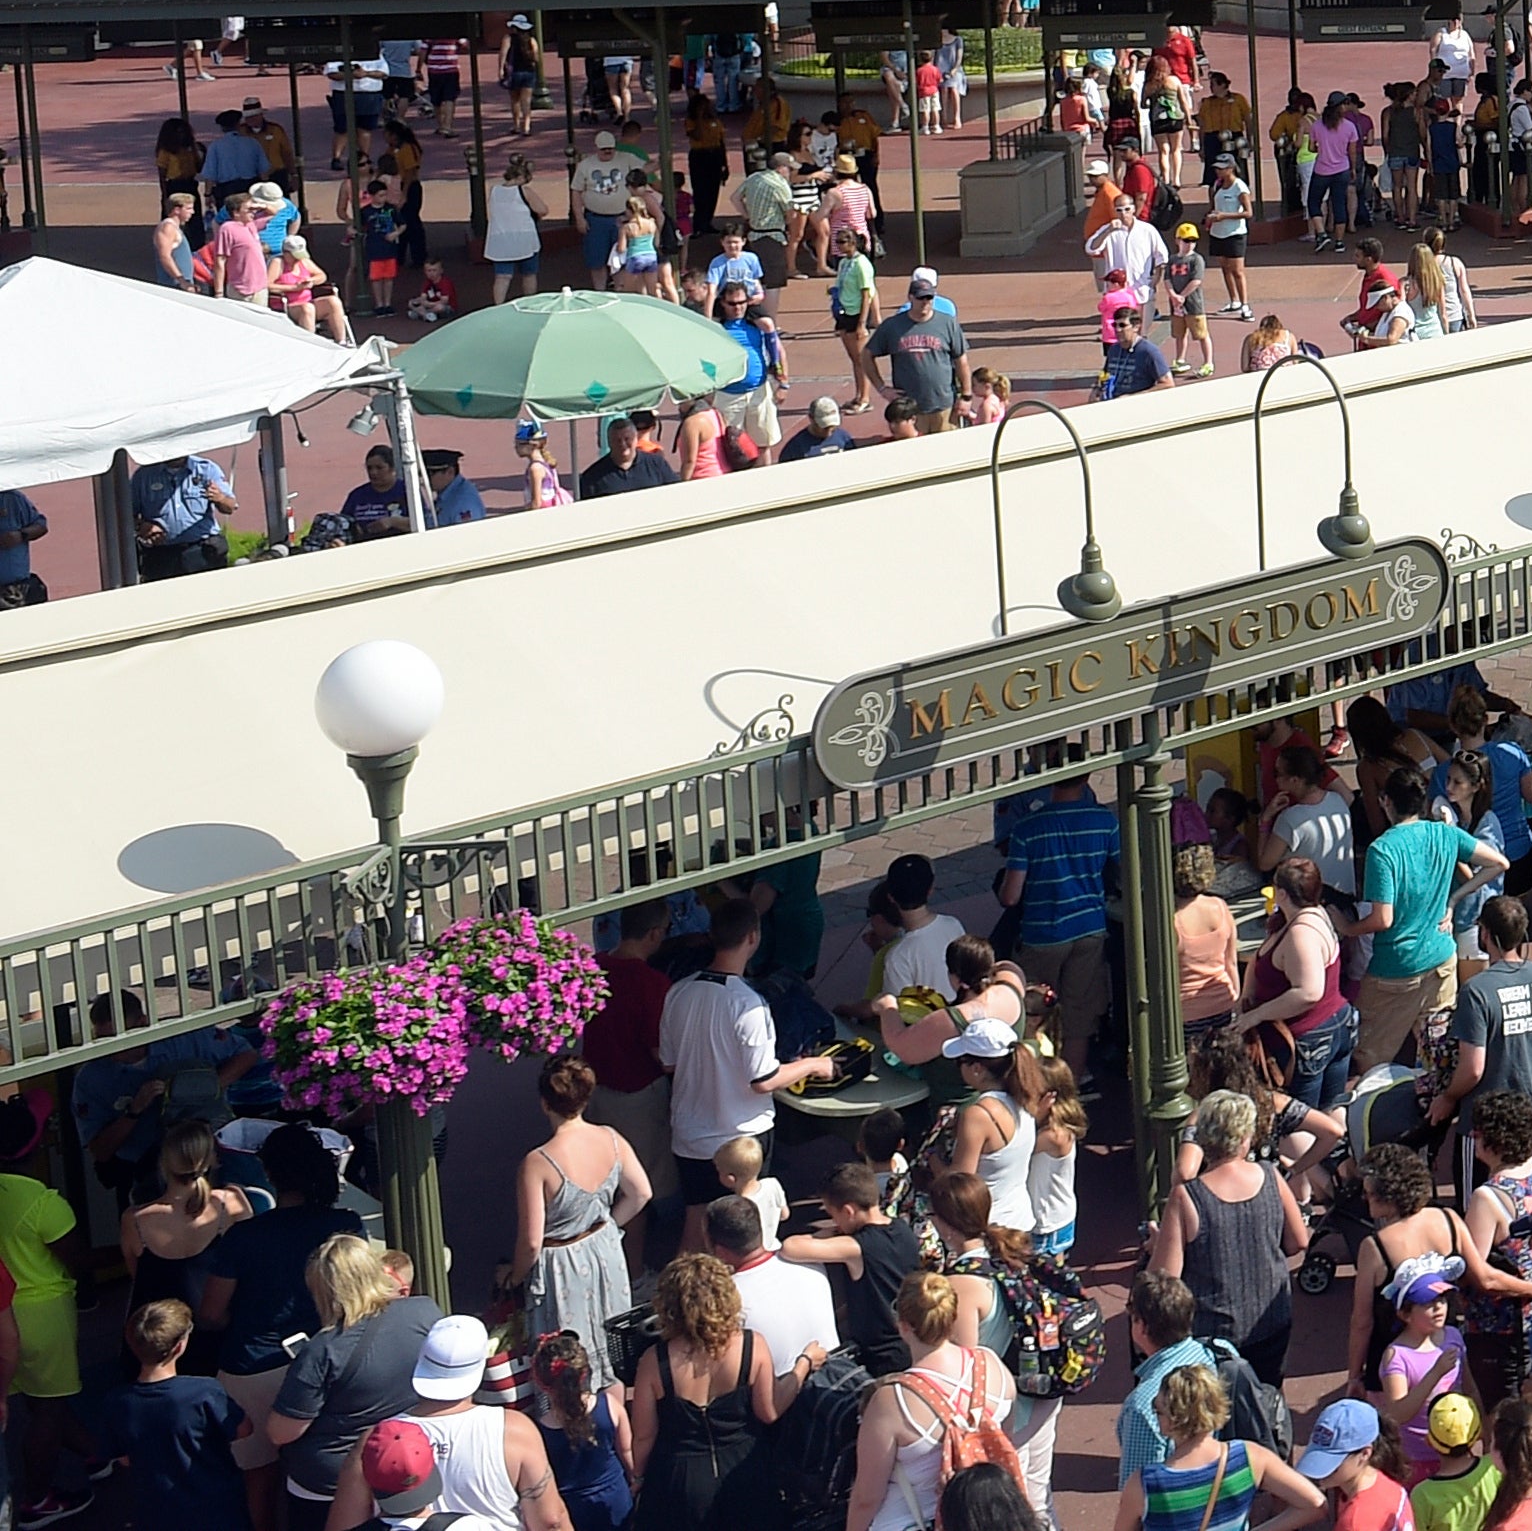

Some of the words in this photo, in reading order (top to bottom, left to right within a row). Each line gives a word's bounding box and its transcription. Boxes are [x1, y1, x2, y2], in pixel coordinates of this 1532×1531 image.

[905, 650, 1101, 740] MAGIC
[1124, 576, 1381, 679] KINGDOM
[1502, 1000, 1531, 1020] LEARN
